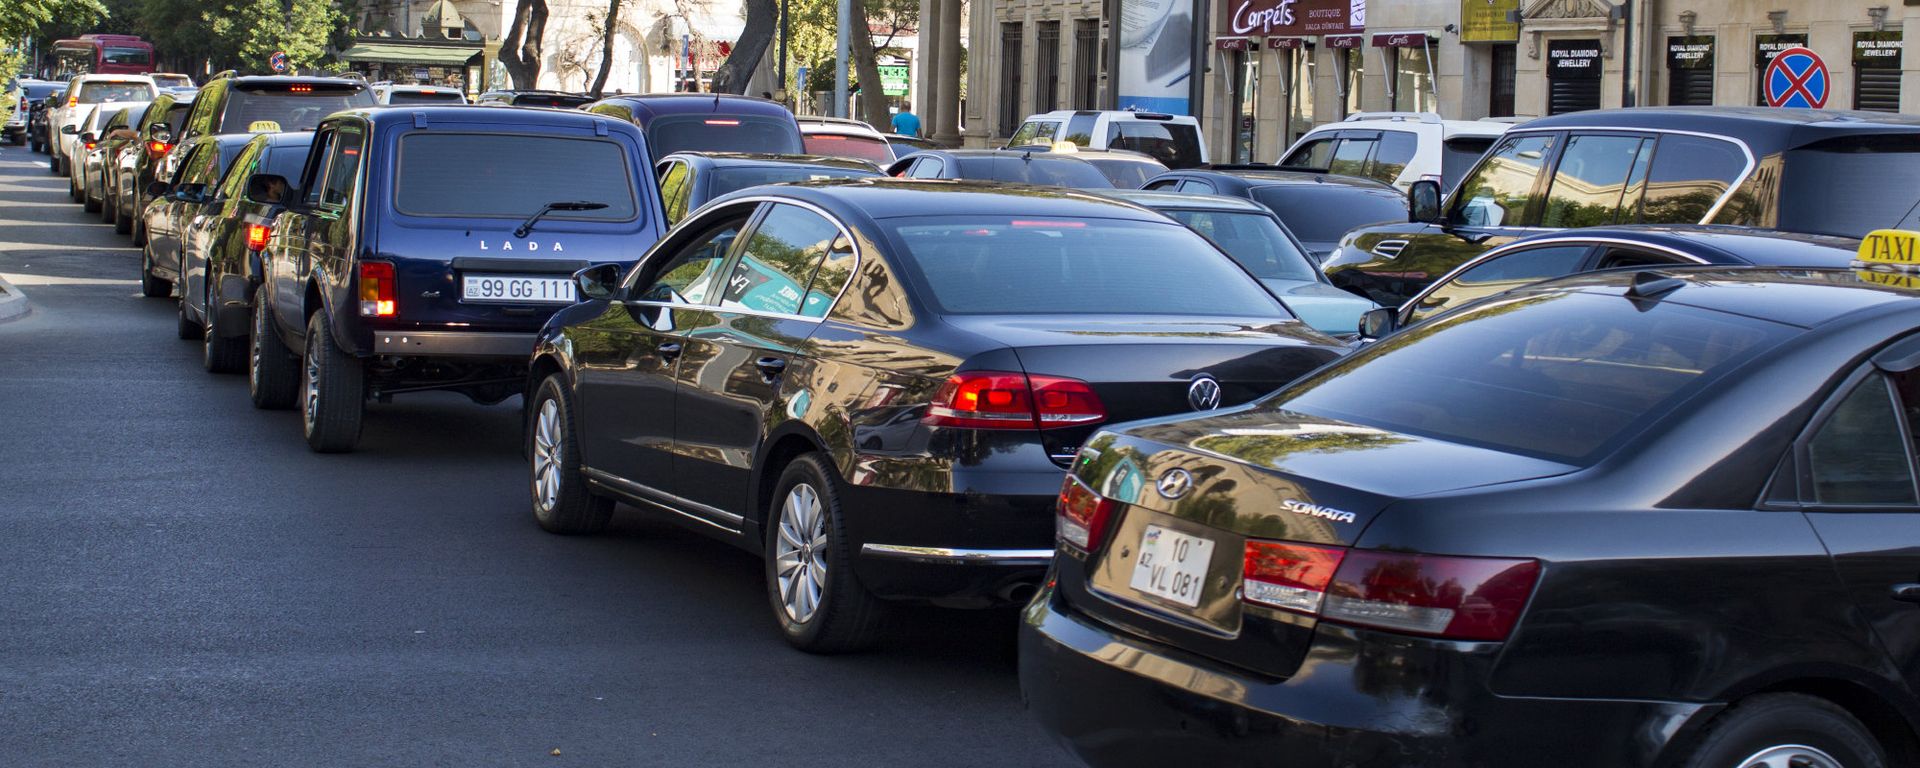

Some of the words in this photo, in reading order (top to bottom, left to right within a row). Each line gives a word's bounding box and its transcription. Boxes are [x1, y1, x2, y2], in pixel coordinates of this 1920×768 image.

[1308, 8, 1341, 18] BOUTIQUE
[1759, 43, 1776, 51] ROYAL
[1857, 41, 1876, 49] ROYAL
[1552, 50, 1570, 58] ROYAL
[1570, 50, 1598, 58] DIAMOND
[1863, 49, 1897, 57] JEWELLERY
[1557, 59, 1591, 67] JEWELLERY
[480, 241, 563, 251] LADA
[1868, 234, 1915, 261] TAXI
[467, 287, 479, 298] AZ
[482, 279, 504, 298] 99
[510, 280, 533, 298] GG
[541, 281, 570, 299] 111
[1280, 500, 1355, 523] SONATA
[1171, 538, 1189, 563] 10
[1139, 551, 1153, 568] AZ
[1149, 564, 1166, 592] VL
[1171, 571, 1199, 601] 081
